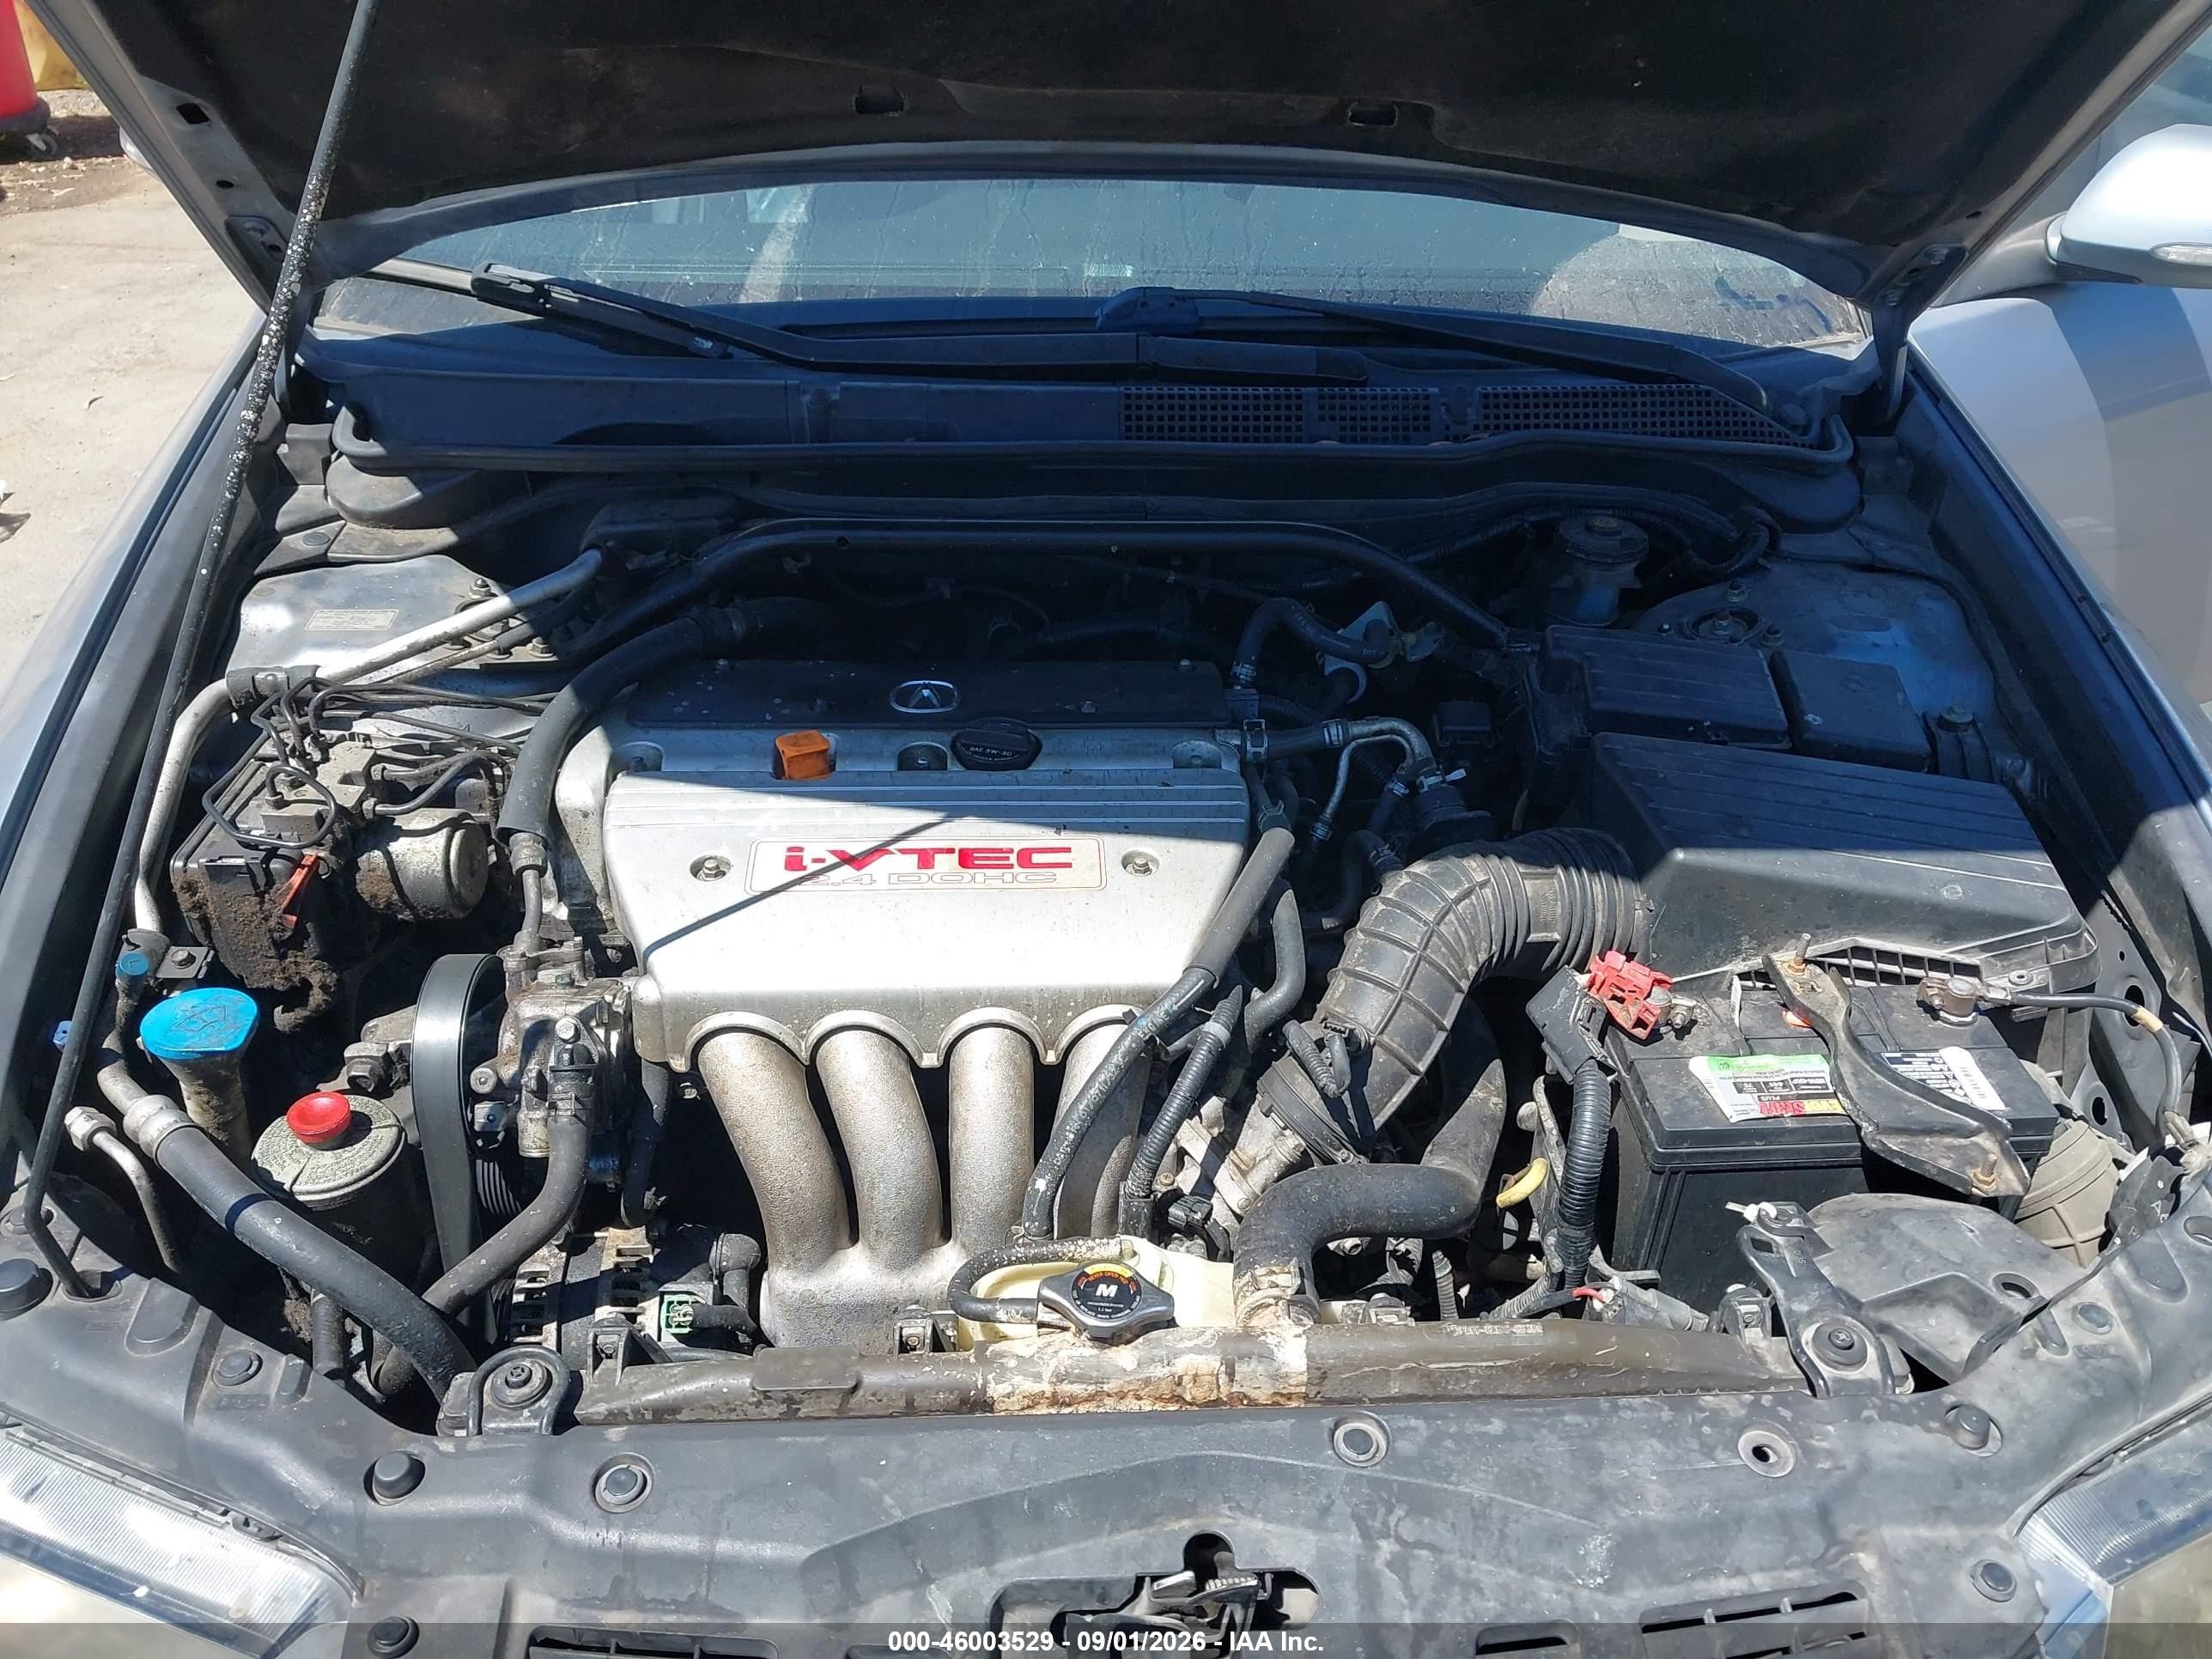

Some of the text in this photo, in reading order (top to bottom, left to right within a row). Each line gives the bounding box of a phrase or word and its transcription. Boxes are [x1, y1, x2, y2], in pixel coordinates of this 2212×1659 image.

[784, 847, 1073, 872] i-VTEC
[798, 872, 1057, 886] 2.4 DOHC
[1088, 1272, 1103, 1282] NEVER
[1095, 1283, 1118, 1297] M
[1079, 1305, 1097, 1316] REPLACE
[1110, 1308, 1131, 1318] CHANGING
